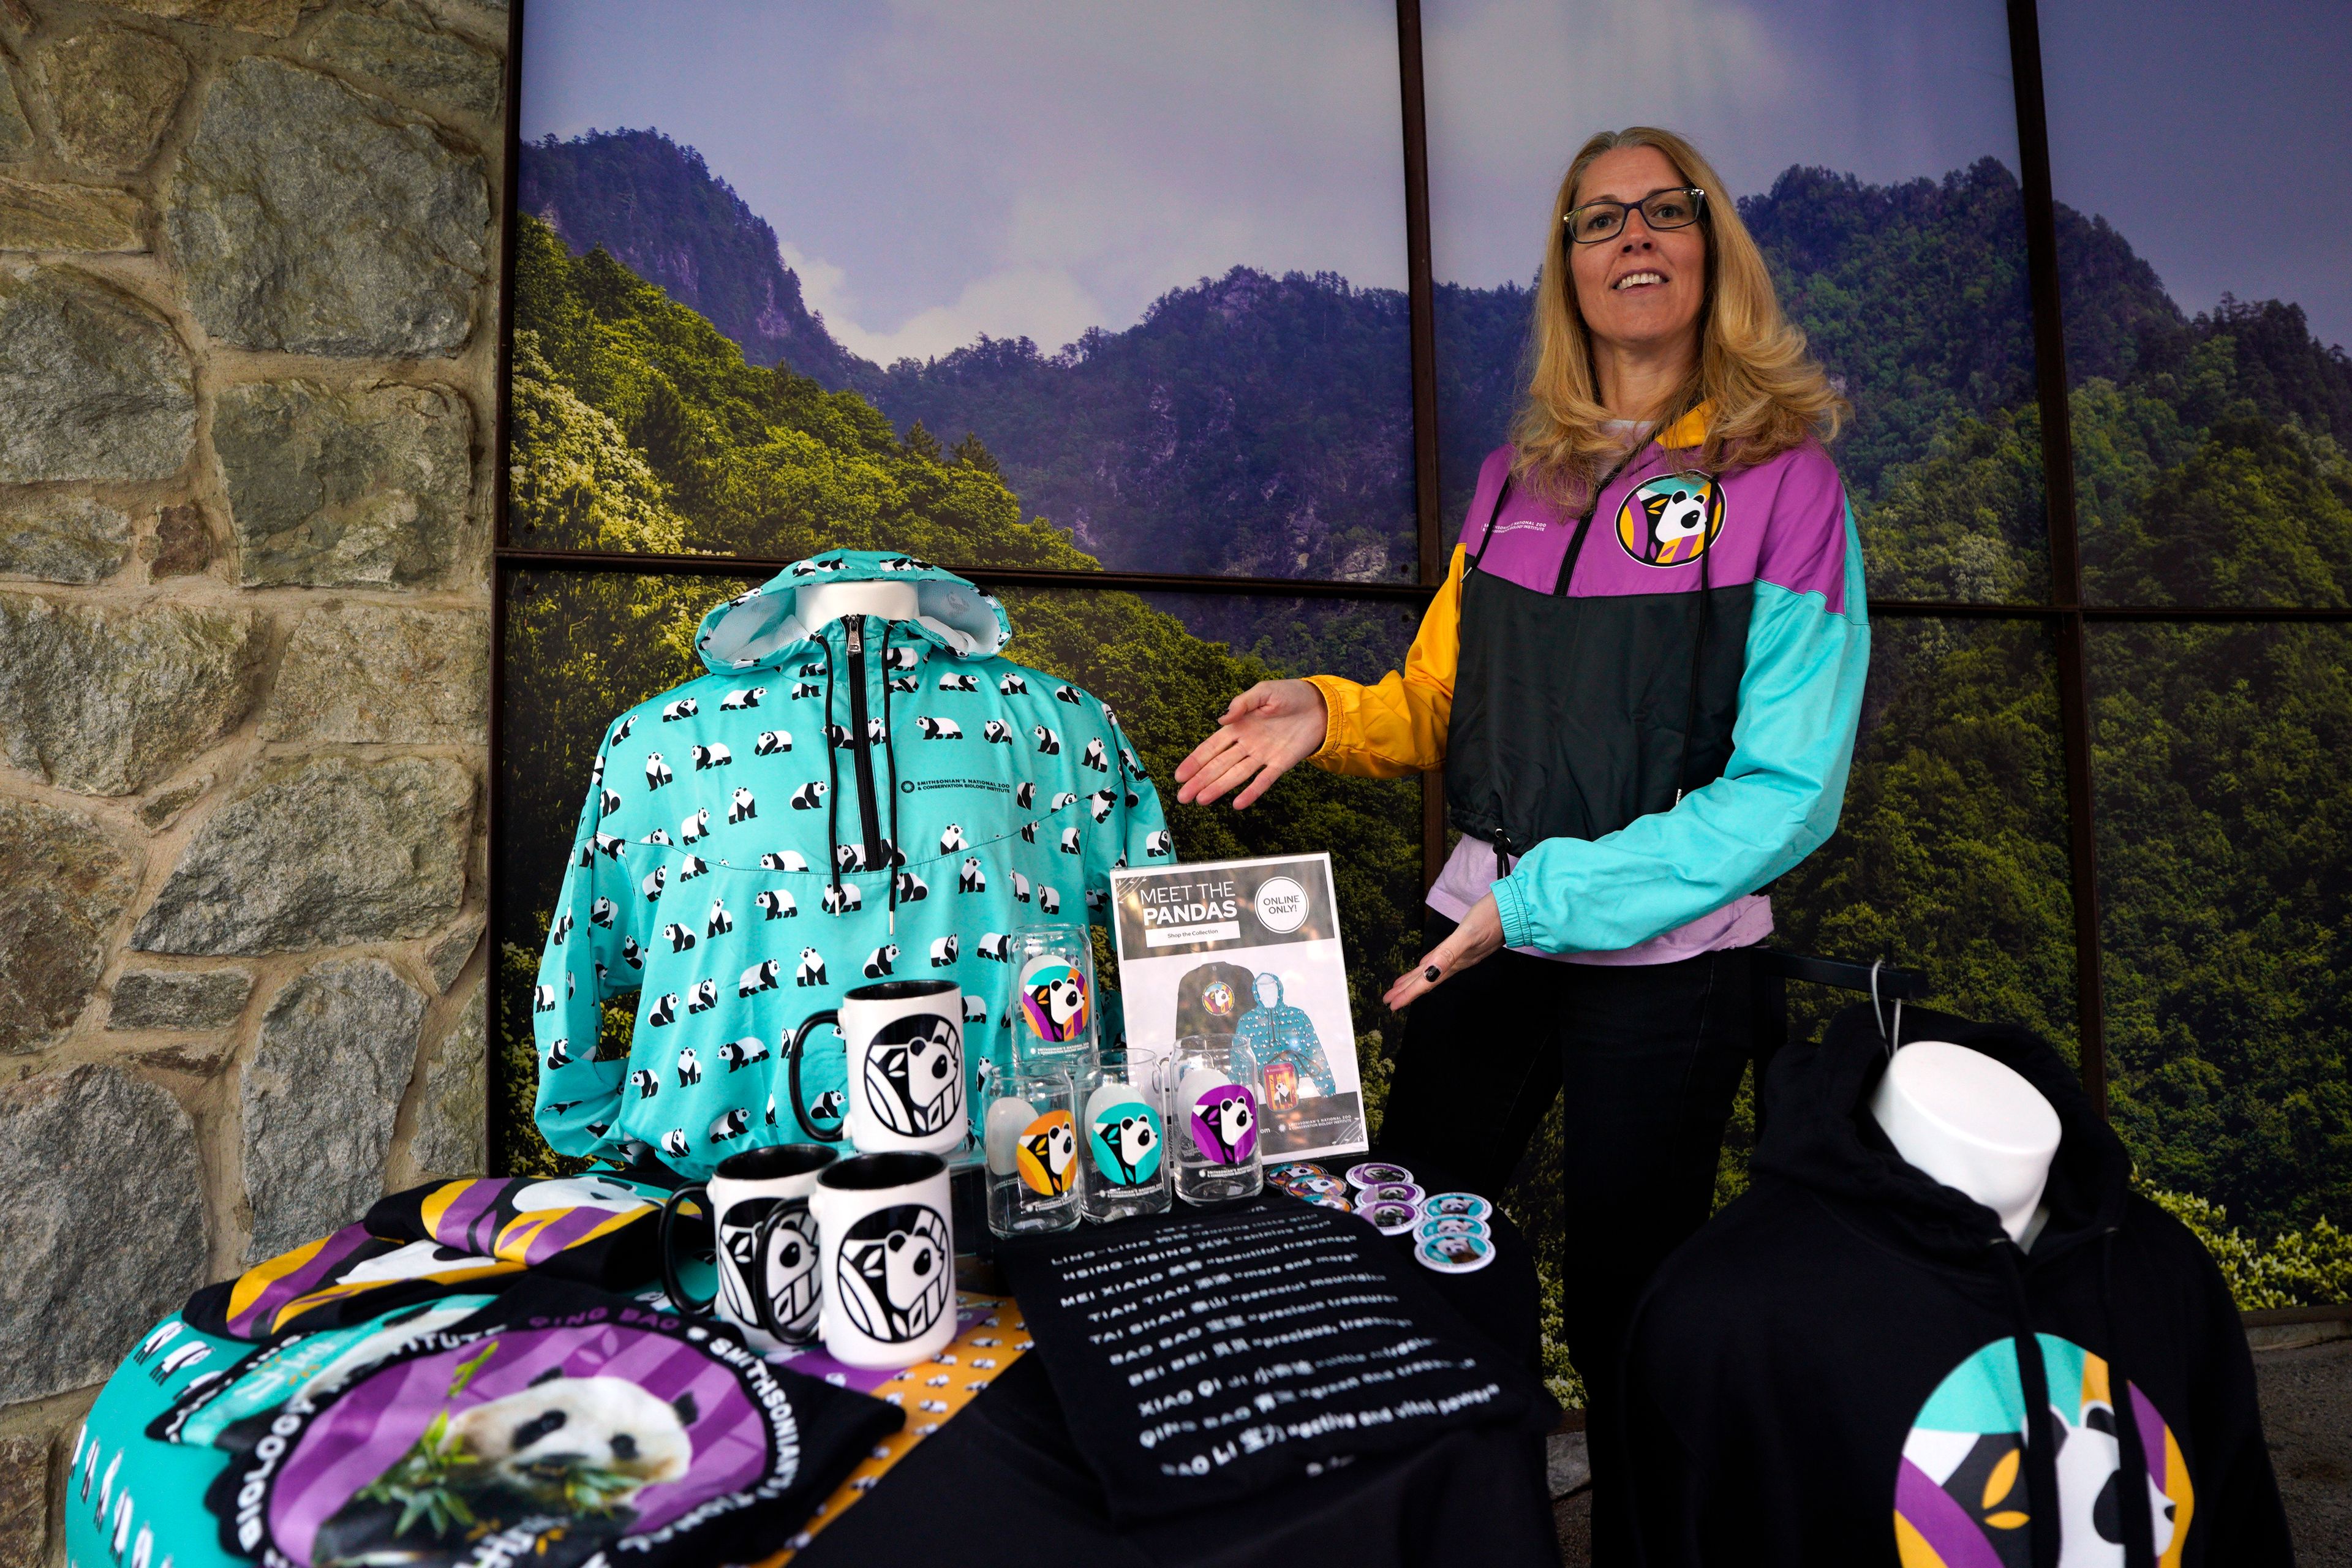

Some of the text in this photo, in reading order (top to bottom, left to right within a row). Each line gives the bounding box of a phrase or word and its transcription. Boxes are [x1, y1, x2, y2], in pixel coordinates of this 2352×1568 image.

[987, 785, 1010, 794] INSTITUTE
[1140, 881, 1236, 905] MEET THE
[1263, 895, 1300, 906] ONLINE
[1268, 905, 1297, 914] ONLY!
[1143, 900, 1237, 926] PANDAS
[1060, 1291, 1096, 1308] MEI
[1101, 1272, 1164, 1297] XIANG
[1088, 1302, 1138, 1323] TIAN
[1142, 1284, 1191, 1305] TIAN
[1284, 1257, 1313, 1271] and
[619, 1307, 680, 1330] BAO
[1088, 1329, 1123, 1345] TAI
[1129, 1308, 1186, 1335] SHAN
[1109, 1344, 1154, 1366] BAO
[1158, 1326, 1202, 1349] BAO
[1128, 1364, 1166, 1387] BEI
[1170, 1349, 1208, 1372] BEI
[1137, 1389, 1194, 1418] XIAO
[1197, 1377, 1223, 1398] QI
[1202, 1406, 1252, 1430] BAO
[1361, 1369, 1395, 1384] and
[1212, 1439, 1238, 1466] LI
[1358, 1406, 1395, 1427] and
[236, 1399, 316, 1553] BIOLOGY
